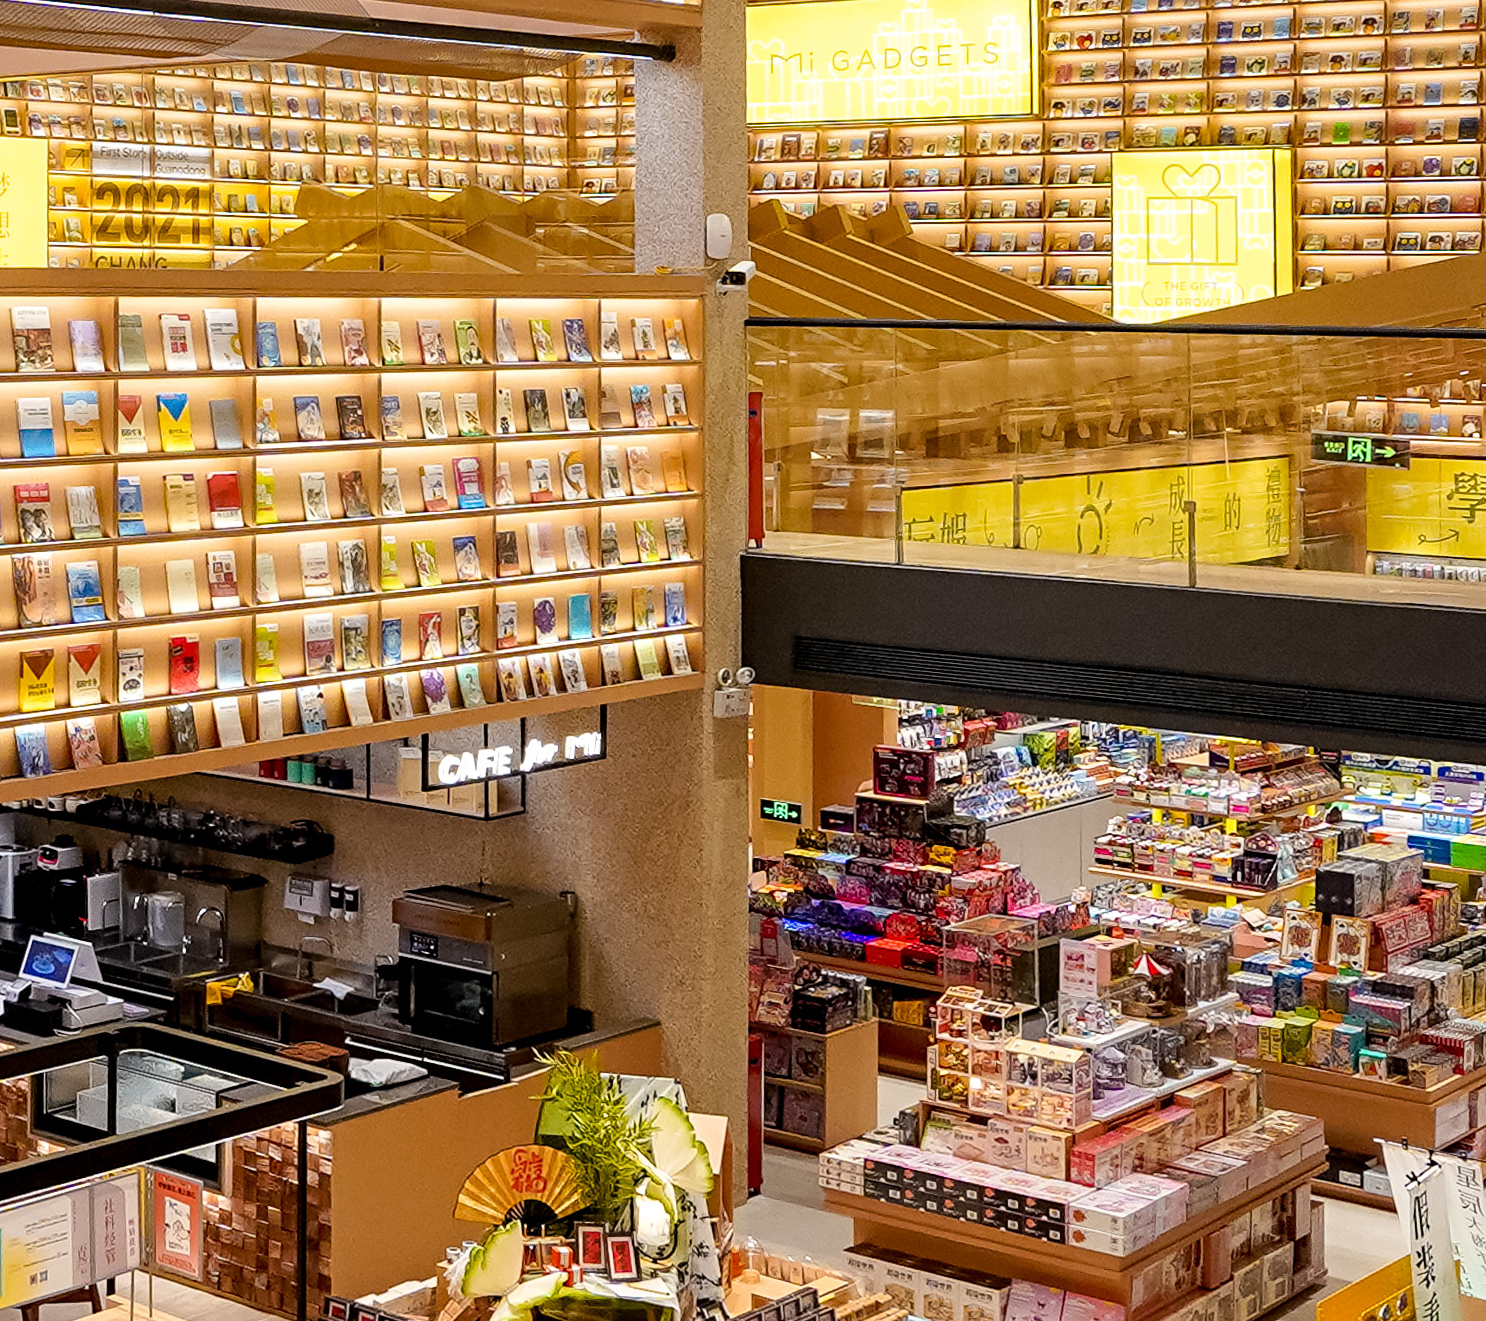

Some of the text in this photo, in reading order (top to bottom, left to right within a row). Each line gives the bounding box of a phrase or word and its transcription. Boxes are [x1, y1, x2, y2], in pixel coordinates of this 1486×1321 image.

[771, 41, 1000, 74] Mi GADGETS
[95, 181, 204, 245] 2021
[438, 745, 512, 785] CAFE
